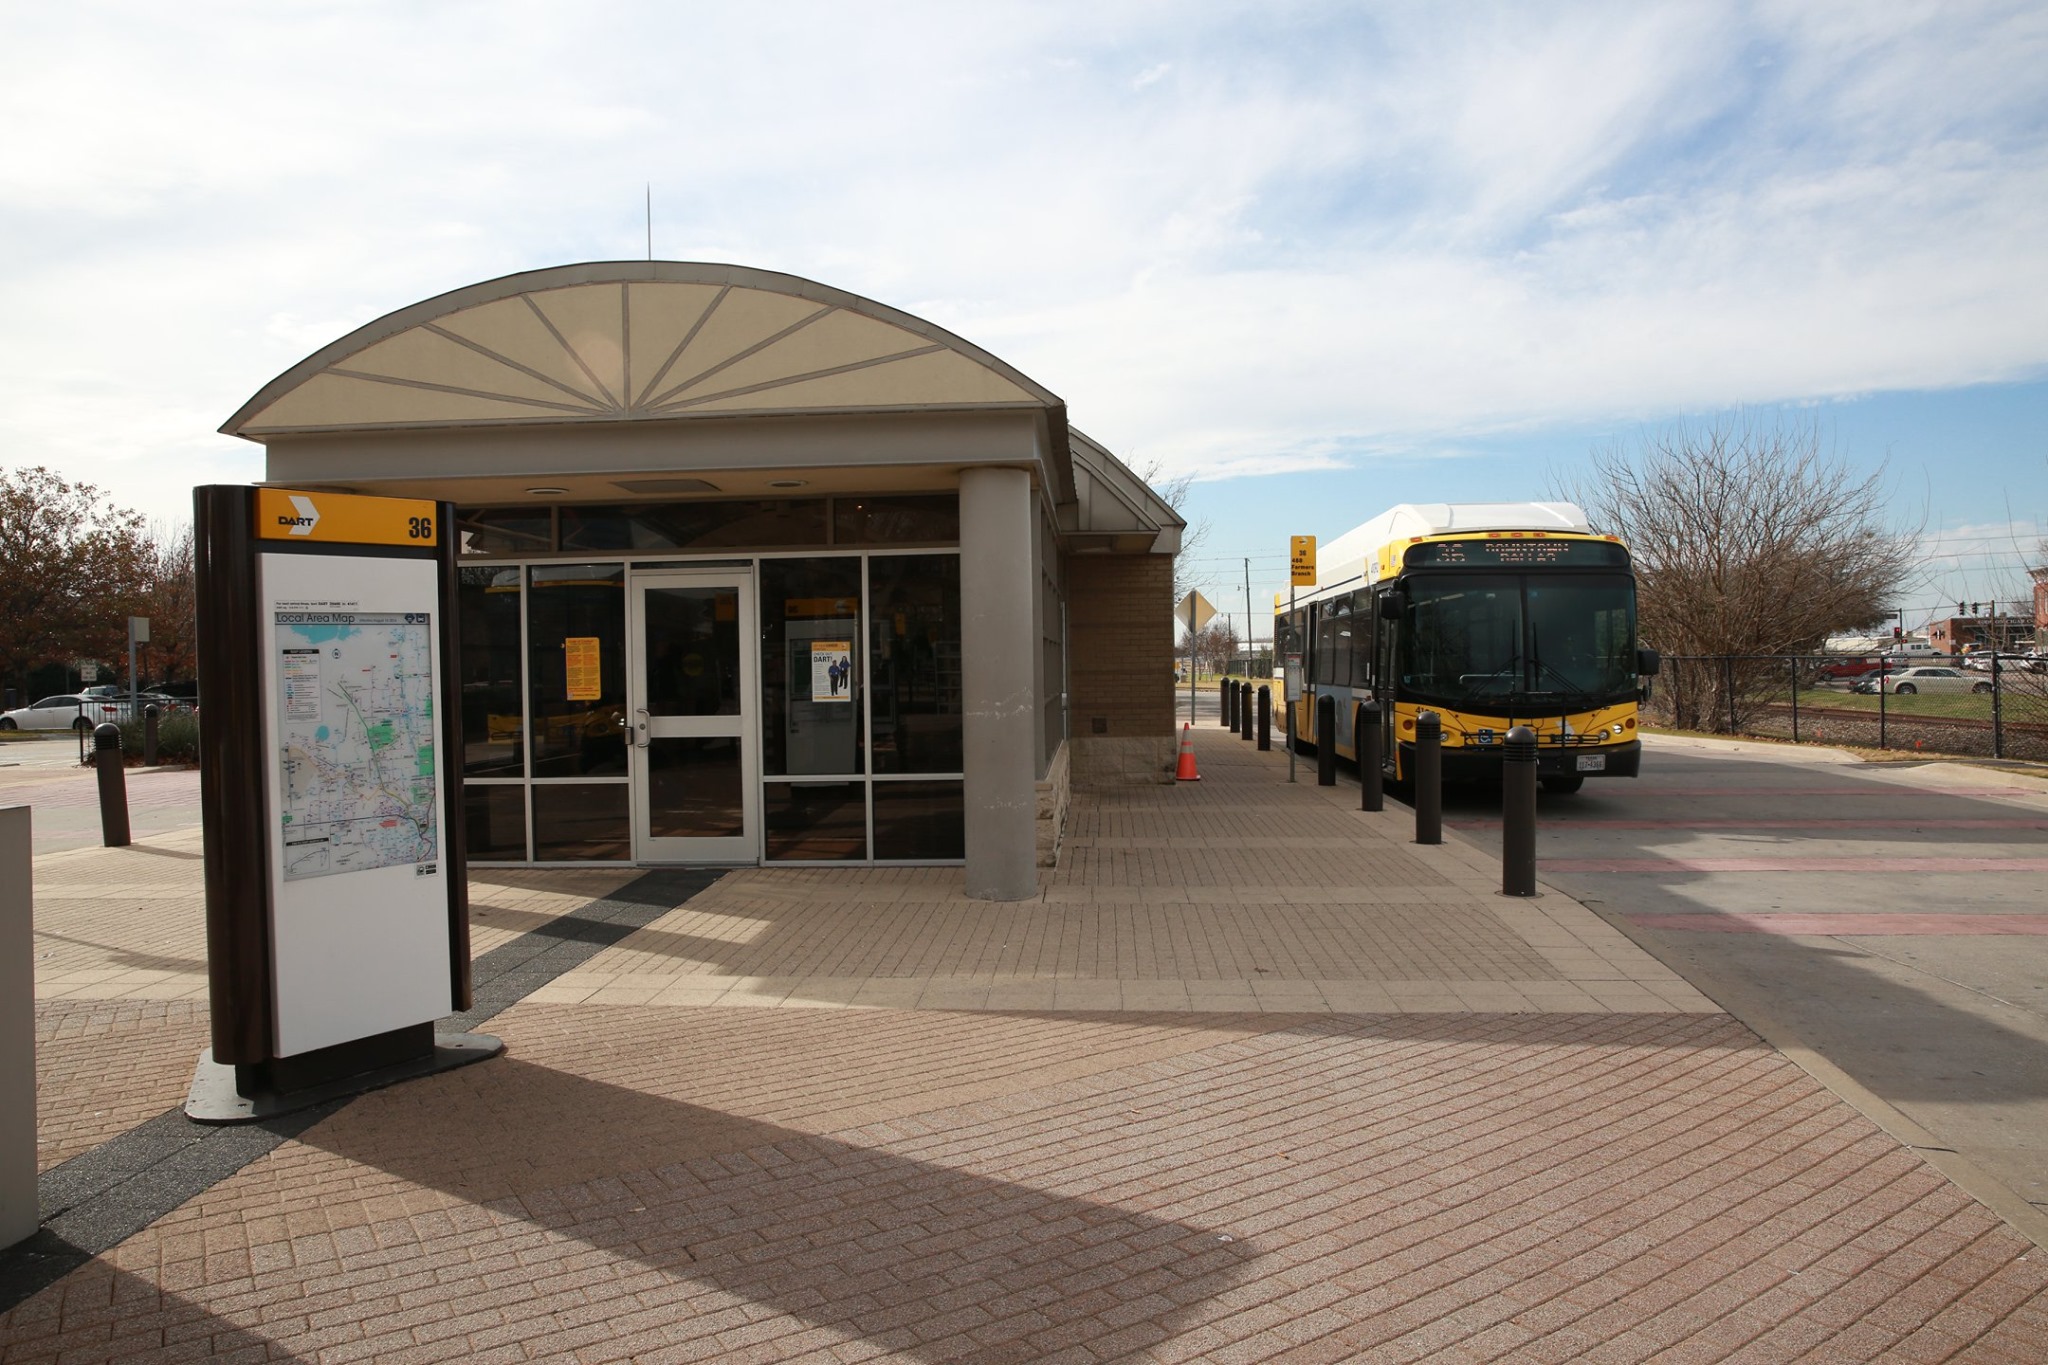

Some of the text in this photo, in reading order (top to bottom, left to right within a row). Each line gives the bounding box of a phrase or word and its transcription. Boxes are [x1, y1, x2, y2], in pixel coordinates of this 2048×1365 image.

[278, 516, 432, 539] DART 36
[276, 613, 356, 625] Local Area Map
